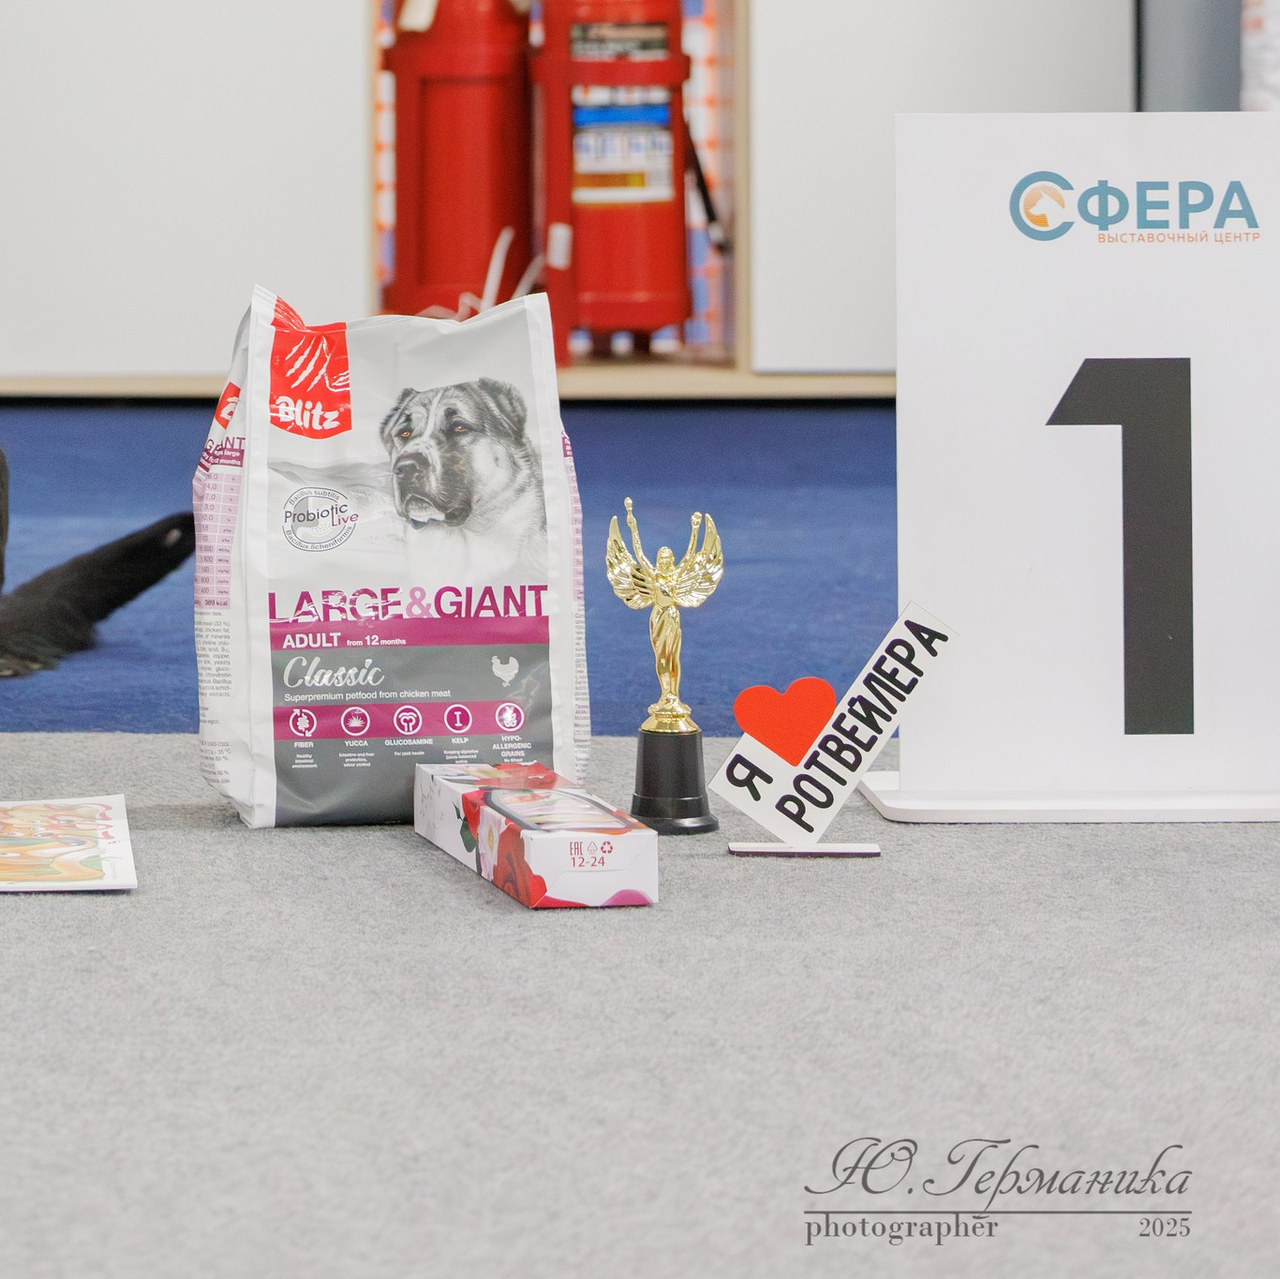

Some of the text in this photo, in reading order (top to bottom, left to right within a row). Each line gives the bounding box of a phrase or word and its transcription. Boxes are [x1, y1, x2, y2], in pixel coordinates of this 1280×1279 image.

[1009, 171, 1259, 241] СФЕРА
[1098, 230, 1261, 244] ВЫСТАВОЧНЫЙ ЦЕНТР
[275, 396, 340, 430] Blitz
[289, 489, 340, 506] Bacillus subtilis
[284, 503, 348, 524] Probiotic
[331, 511, 359, 527] Live
[286, 529, 309, 550] Bacillus
[1045, 358, 1194, 734] 1
[282, 632, 341, 649] ADULT
[365, 635, 379, 645] 12
[283, 656, 385, 688] Classic
[284, 693, 344, 702] Superpremium
[345, 691, 377, 701] petfood
[399, 689, 429, 698] chicken
[431, 689, 451, 697] meat
[726, 620, 949, 833] Я РОТВЕЙЛЕРА
[384, 738, 433, 746] GLUCOSAMINE
[492, 742, 532, 750] ALLERGENIC
[570, 856, 606, 868] 12-24
